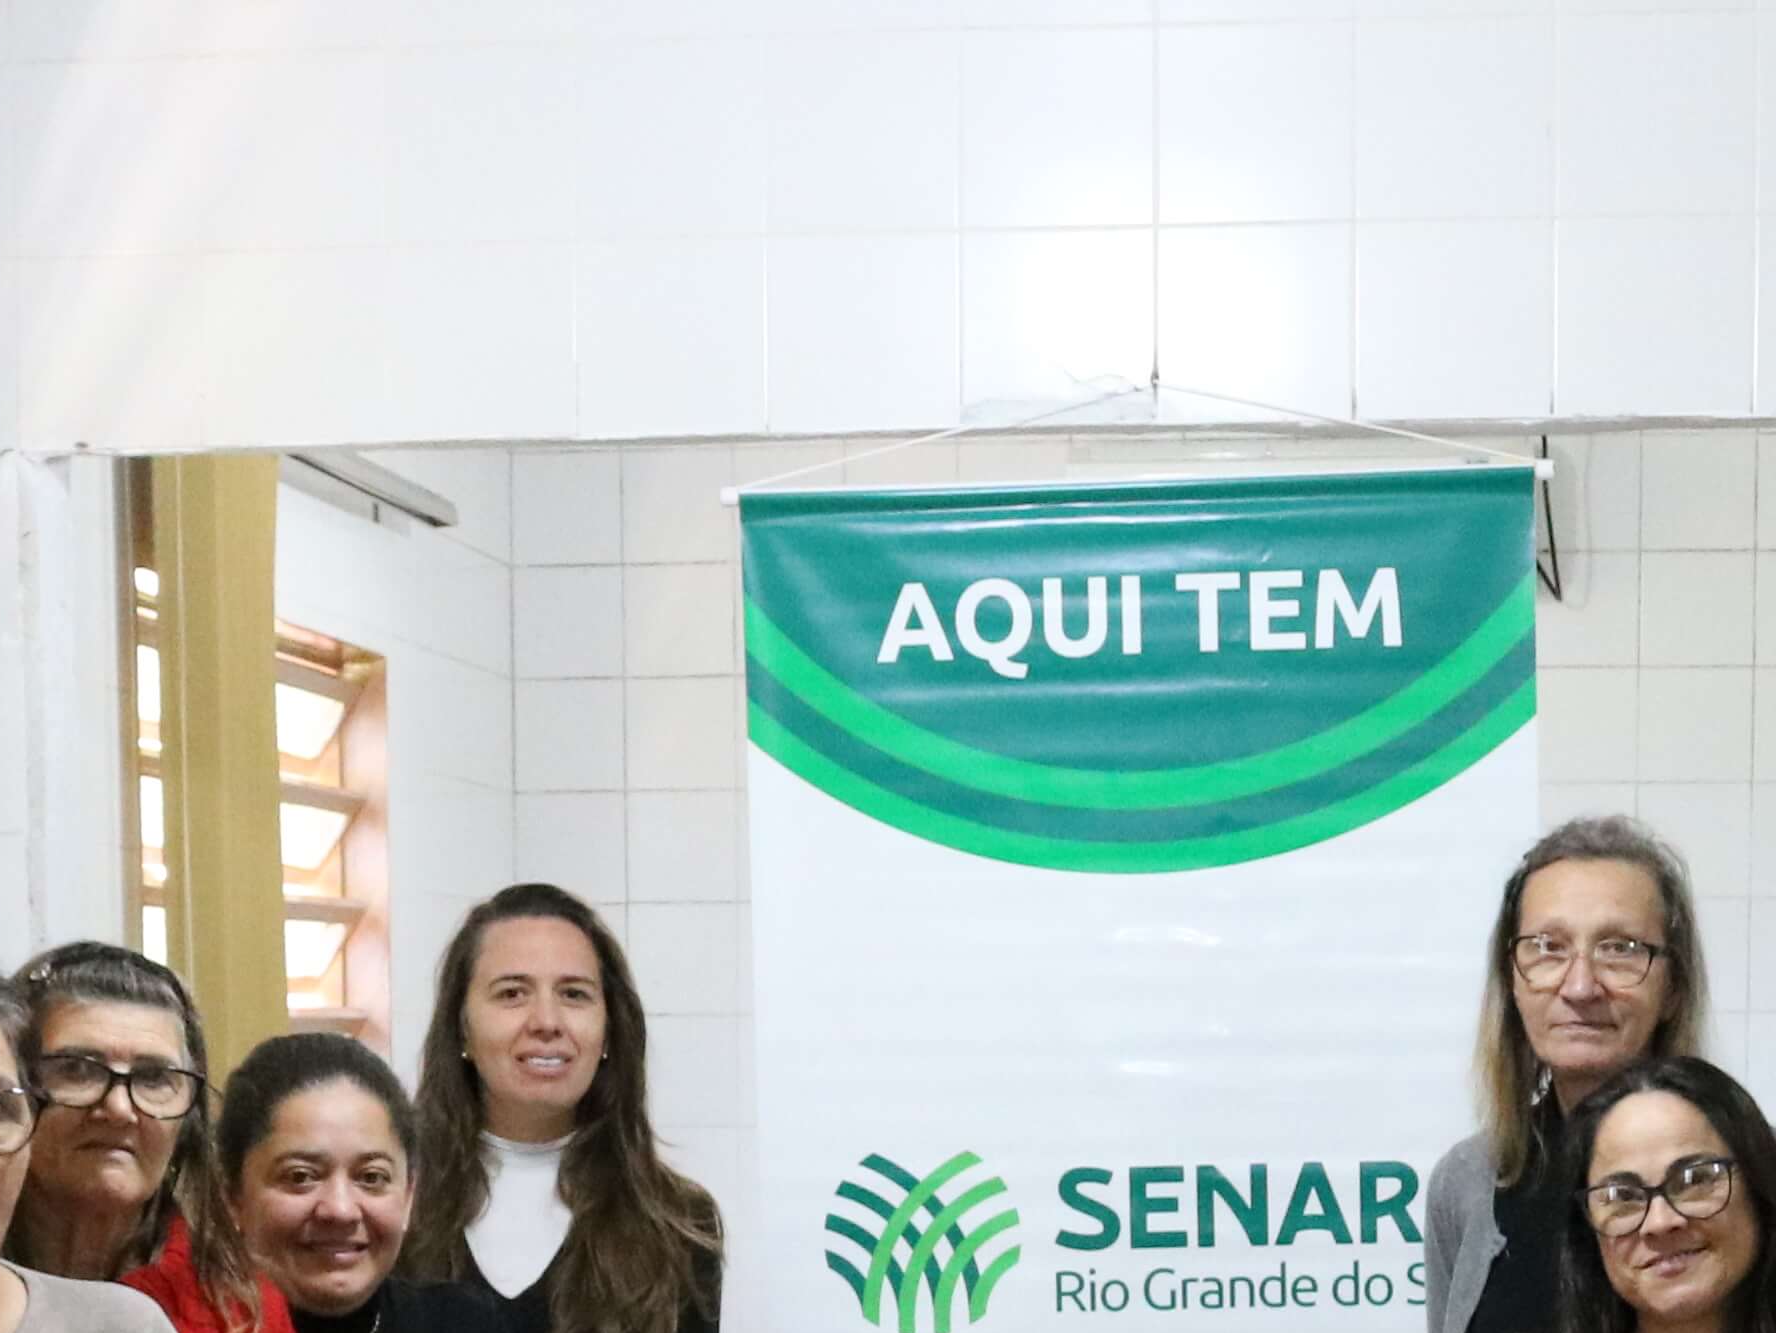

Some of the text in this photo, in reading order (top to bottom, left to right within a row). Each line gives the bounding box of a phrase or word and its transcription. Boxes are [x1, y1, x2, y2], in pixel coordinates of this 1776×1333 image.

[877, 567, 1403, 679] AQUI TEM
[1055, 1161, 1423, 1251] SENAR
[1056, 1269, 1129, 1313] Rio
[1143, 1261, 1318, 1312] Grande
[1332, 1260, 1393, 1307] do
